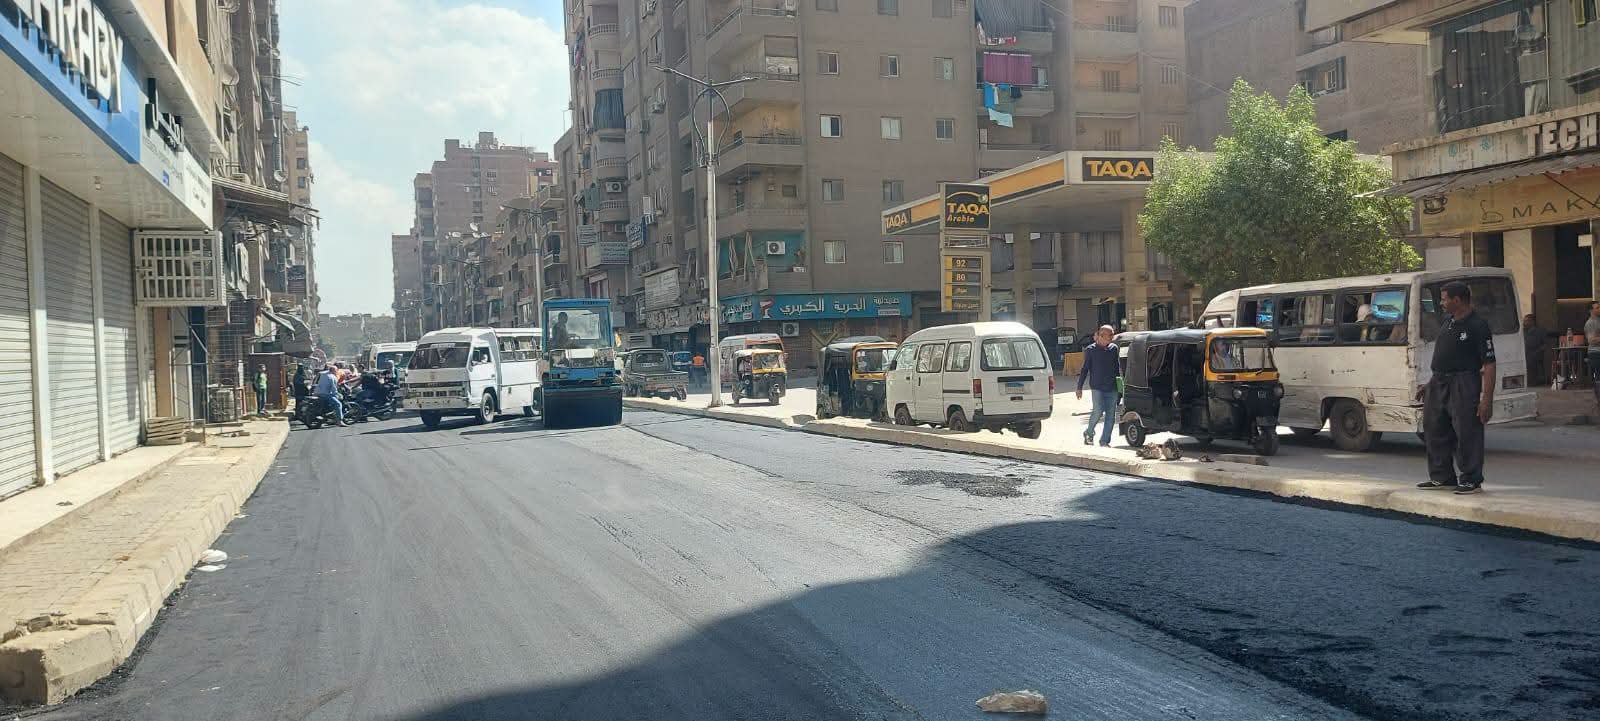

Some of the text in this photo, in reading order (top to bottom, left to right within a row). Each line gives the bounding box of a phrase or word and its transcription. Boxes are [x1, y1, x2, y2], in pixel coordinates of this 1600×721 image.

[1523, 113, 1598, 157] TECH
[1086, 160, 1152, 179] TAQA
[947, 202, 990, 215] TAQA
[885, 212, 908, 229] TAQA
[955, 259, 967, 268] 92
[833, 297, 866, 314] الحرية
